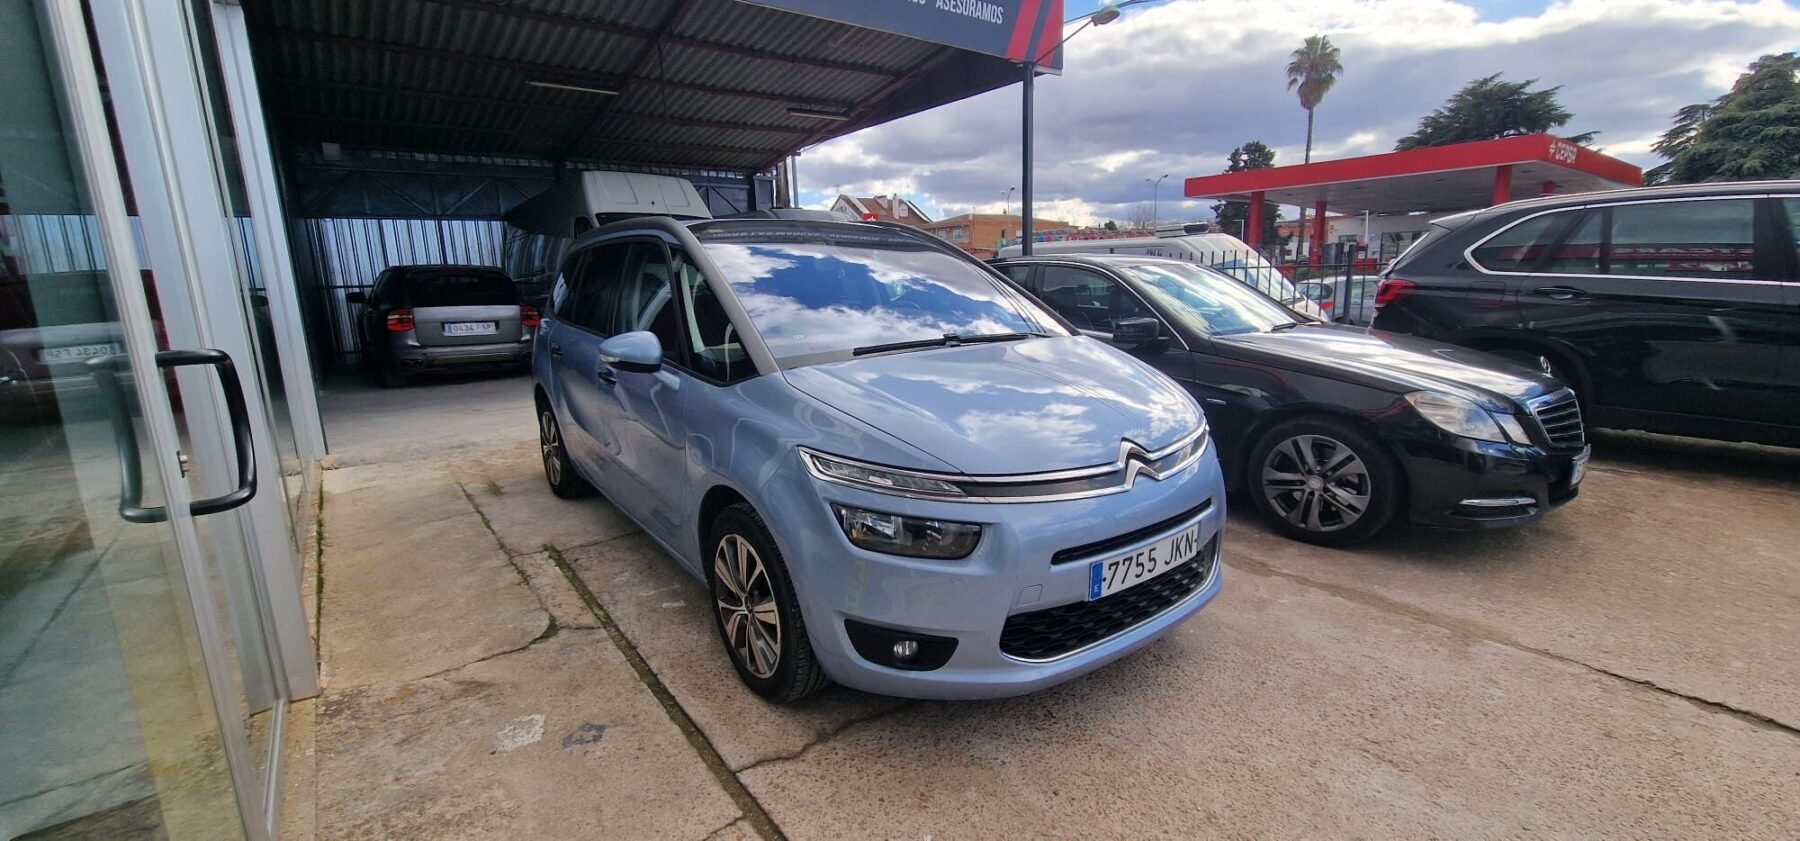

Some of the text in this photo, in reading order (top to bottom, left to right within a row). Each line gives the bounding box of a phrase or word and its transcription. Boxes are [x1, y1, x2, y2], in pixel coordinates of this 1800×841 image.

[935, 0, 1004, 25] ASESORAMOS
[1555, 142, 1577, 164] CEPSA
[1107, 529, 1194, 590] 7755 JKN
